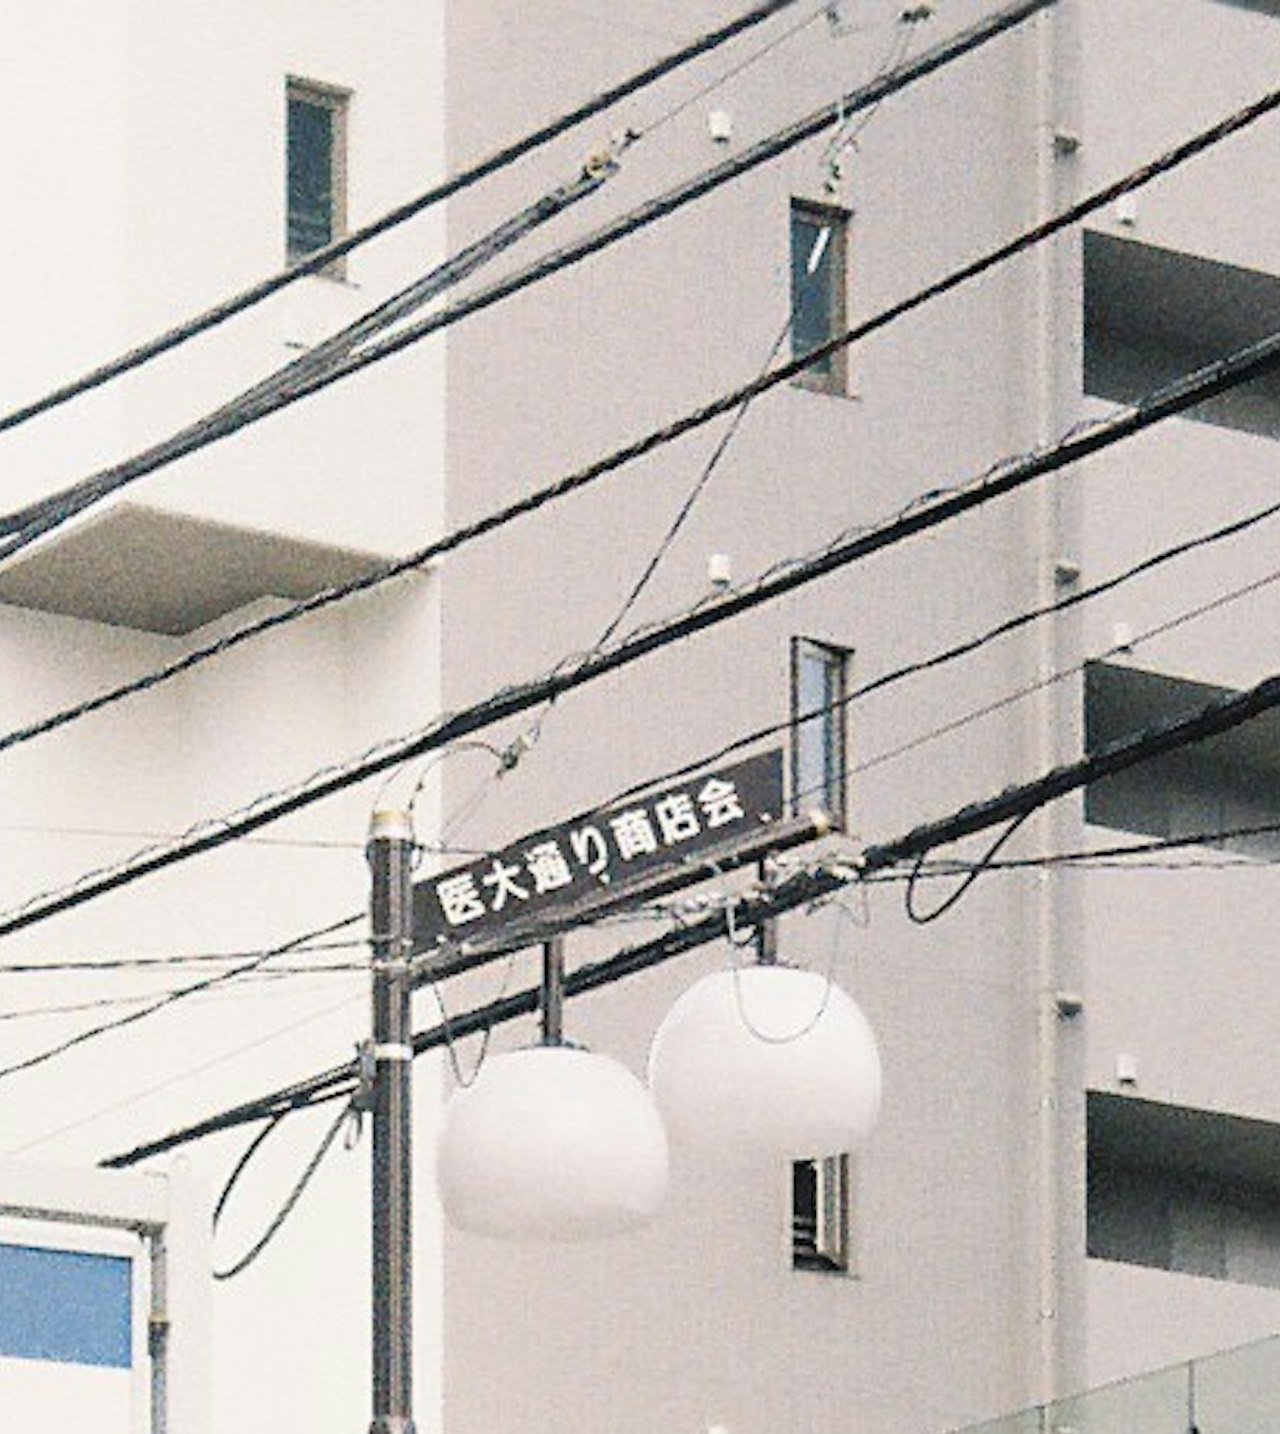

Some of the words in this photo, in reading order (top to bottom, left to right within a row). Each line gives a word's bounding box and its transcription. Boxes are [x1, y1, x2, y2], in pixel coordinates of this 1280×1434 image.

[435, 779, 746, 927] 医大通り商店会
